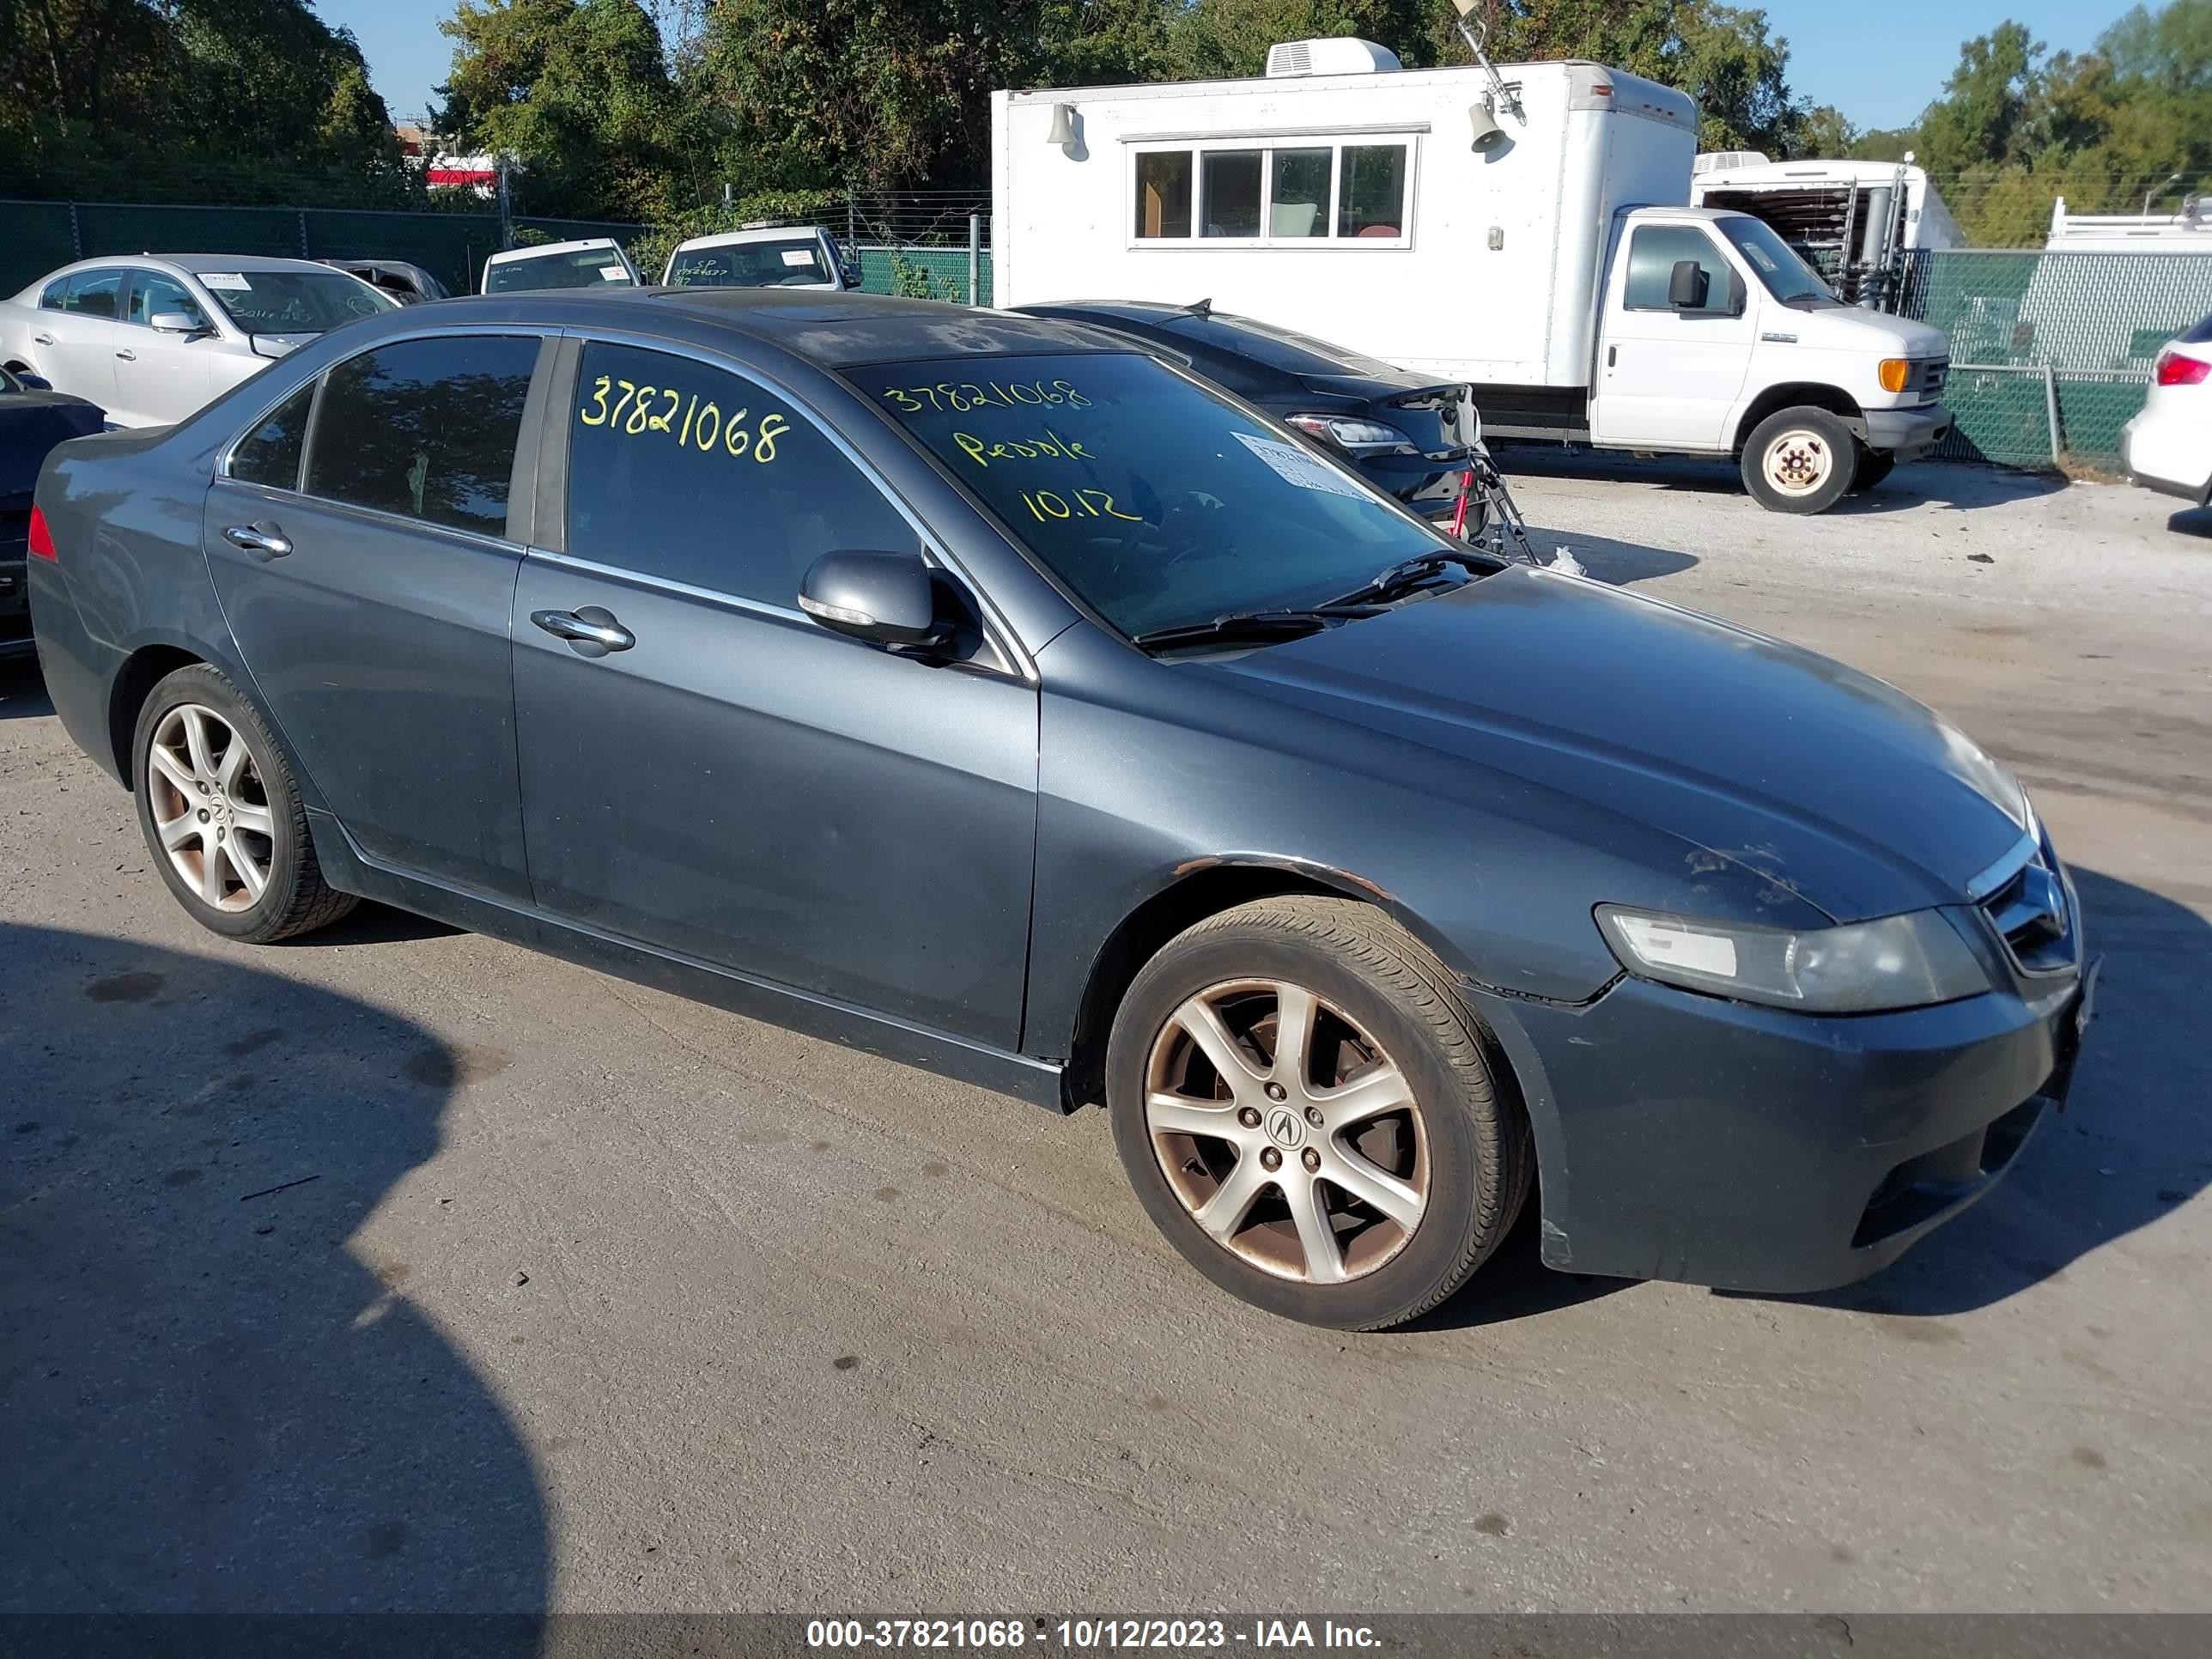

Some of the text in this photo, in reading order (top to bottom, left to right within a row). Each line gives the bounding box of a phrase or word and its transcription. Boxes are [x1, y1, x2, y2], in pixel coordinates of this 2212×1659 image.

[884, 380, 1093, 412] 37821068
[581, 375, 791, 463] 37821068
[1018, 489, 1145, 523] 10.12
